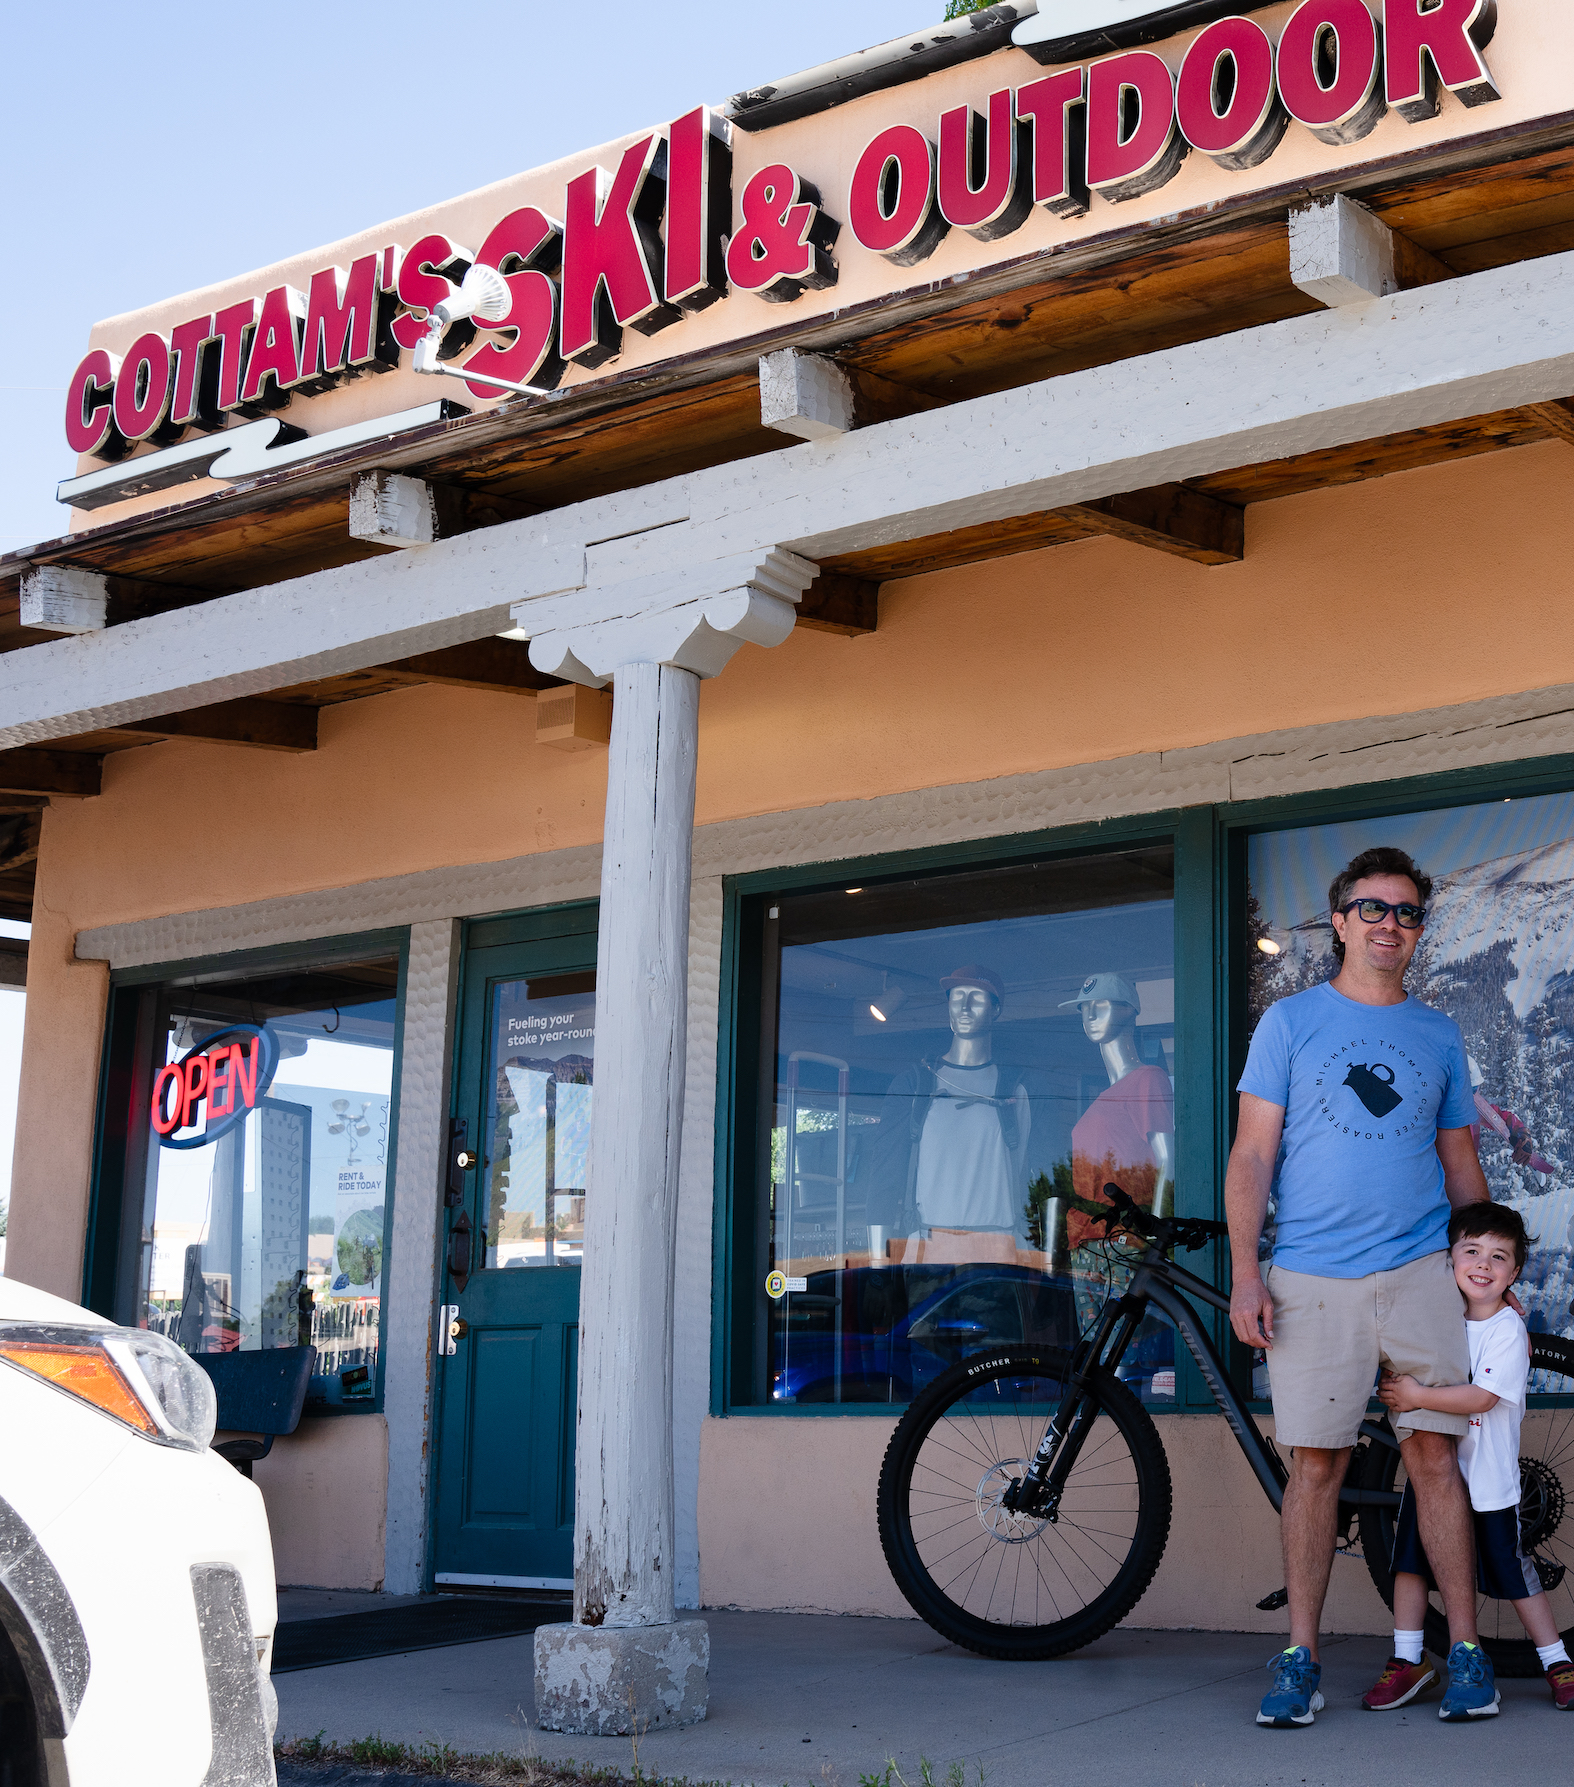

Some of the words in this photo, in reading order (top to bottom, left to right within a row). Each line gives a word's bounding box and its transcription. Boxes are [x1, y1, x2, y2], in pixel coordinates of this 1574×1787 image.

[64, 230, 470, 458] COTTAM'S
[461, 102, 725, 401] SKI
[725, 162, 832, 294] &
[848, 0, 1494, 256] OUTDOOR
[507, 1032, 537, 1047] stoke
[508, 1015, 547, 1031] Fueling
[549, 1013, 574, 1029] your
[1316, 1039, 1368, 1086] MICHAEL
[1379, 1039, 1428, 1087] THOMAS
[151, 1036, 260, 1135] OPEN
[1319, 1098, 1384, 1140] ROASTERS
[1394, 1098, 1428, 1137] COFFEE
[338, 1172, 358, 1181] RENT
[358, 1171, 365, 1181] &
[338, 1181, 355, 1191] RIDE
[356, 1180, 382, 1190] TODAY
[967, 1357, 1011, 1376] BUTCHER
[1534, 1347, 1567, 1362] ATORY
[1178, 1320, 1244, 1435] SPECIALIZED
